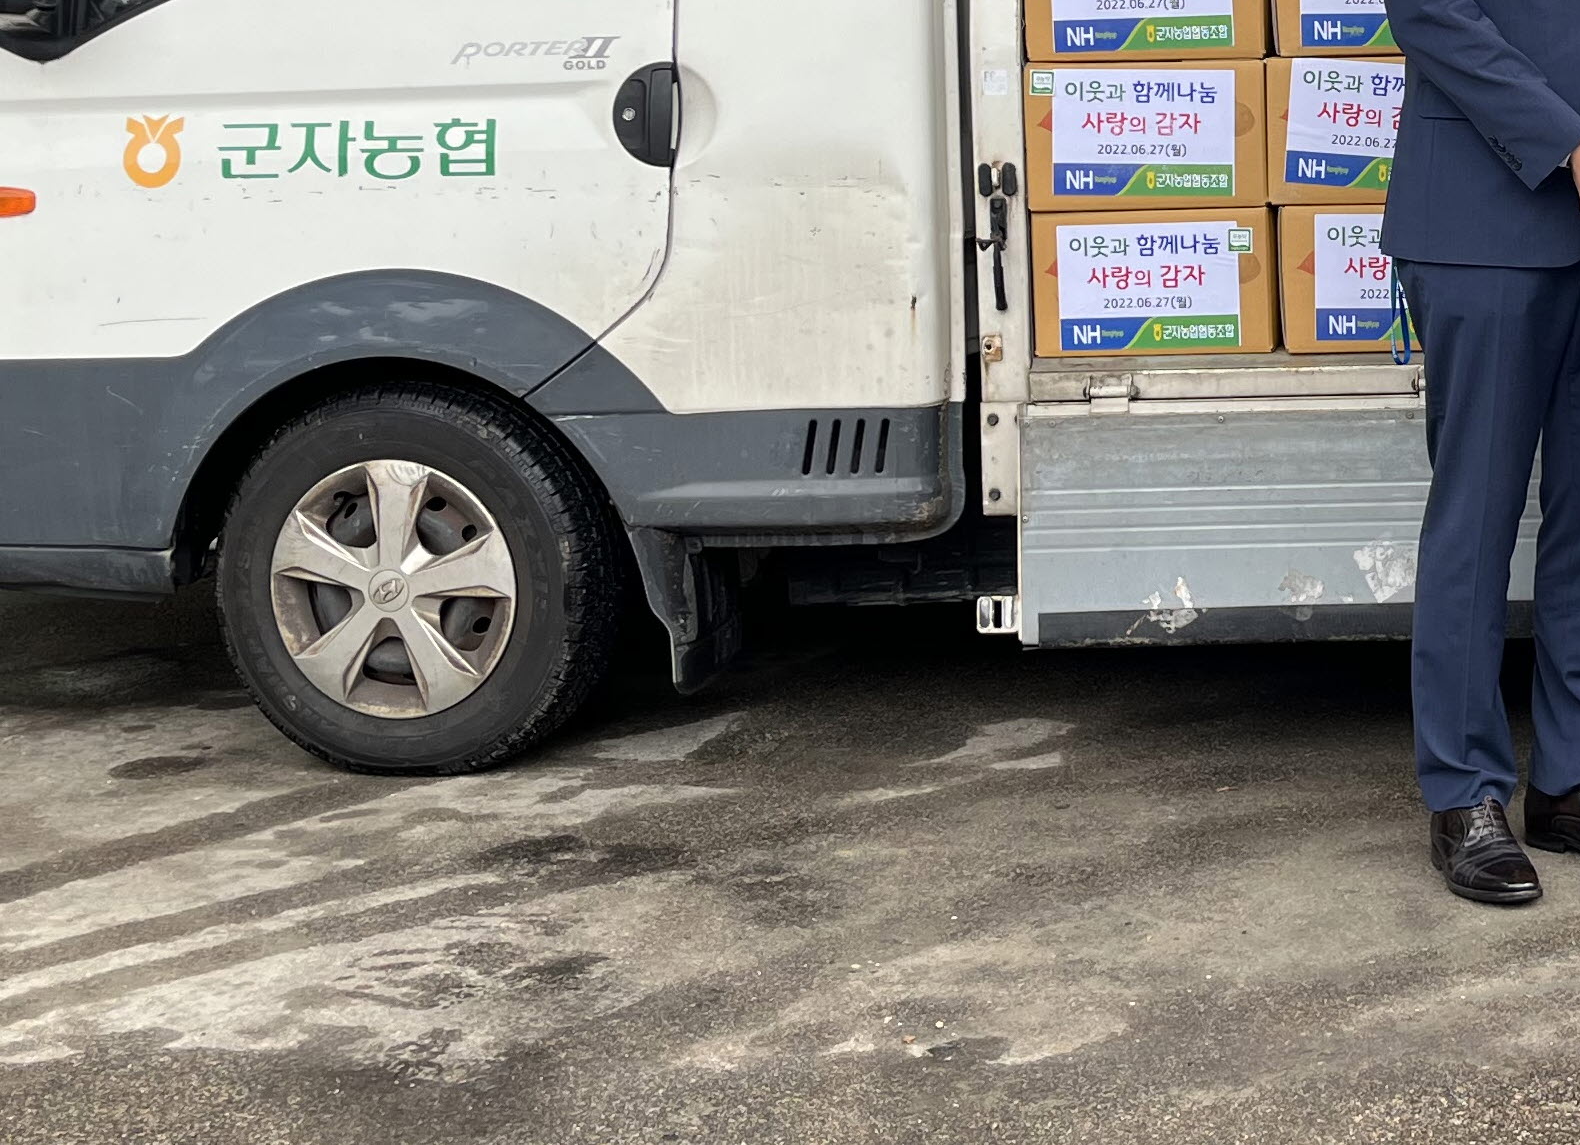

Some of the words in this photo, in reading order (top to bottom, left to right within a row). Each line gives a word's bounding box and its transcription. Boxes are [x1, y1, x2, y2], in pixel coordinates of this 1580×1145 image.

[1067, 27, 1094, 47] NH
[1314, 21, 1341, 40] NH
[450, 40, 589, 66] PORTER
[563, 60, 606, 71] GOLD
[1065, 81, 1126, 103] 이웃과
[1133, 80, 1218, 104] 함께나눔
[1303, 70, 1364, 93] 이웃과
[1081, 112, 1146, 136] 사랑의
[1155, 112, 1201, 136] 감자
[1317, 102, 1382, 128] 사랑의
[217, 118, 497, 180] 군자농협
[1097, 143, 1187, 157] 2022.06.27(월)
[1066, 169, 1093, 190] NH
[1298, 159, 1325, 179] NH
[1069, 235, 1129, 257] 이웃과
[1136, 234, 1220, 256] 함께나눔
[1087, 266, 1151, 290] 사랑의
[1160, 265, 1206, 288] 감자
[1103, 295, 1192, 309] 2022.06.27(월)
[1073, 325, 1100, 344] NH
[1329, 315, 1356, 334] NH
